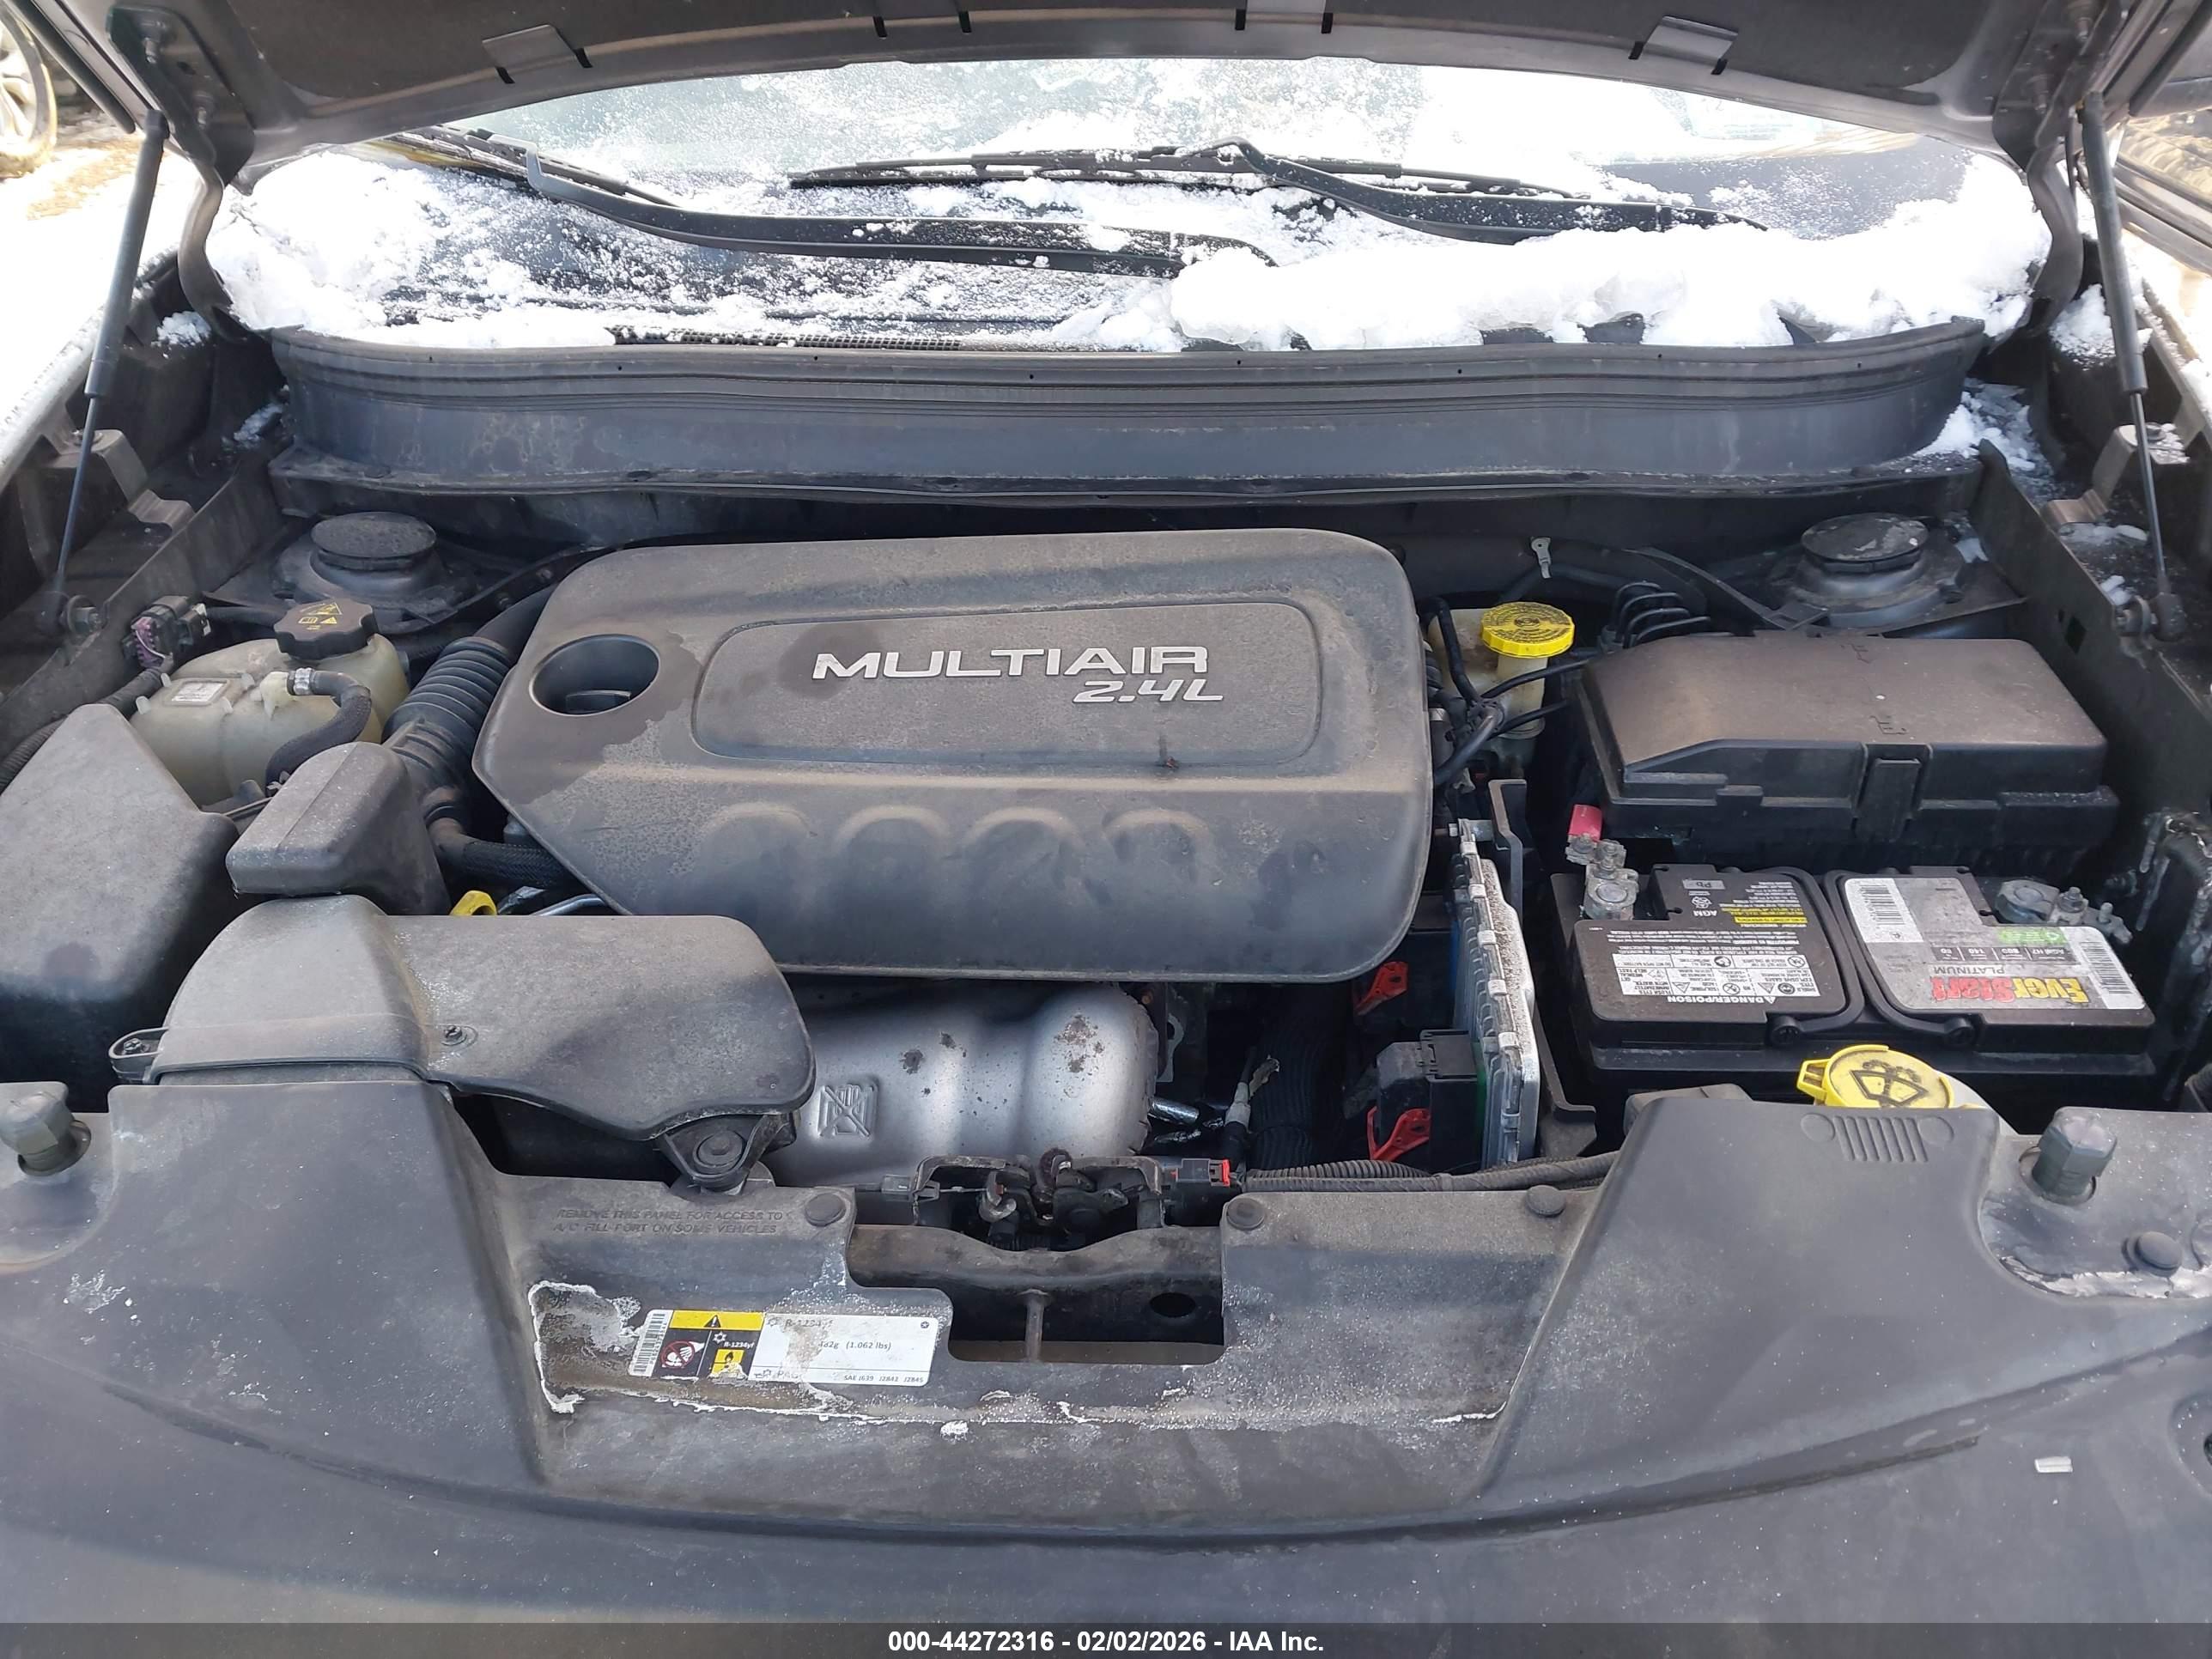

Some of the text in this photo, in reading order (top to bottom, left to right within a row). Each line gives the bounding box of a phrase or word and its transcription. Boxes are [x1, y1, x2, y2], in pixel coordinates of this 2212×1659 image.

[811, 645, 1210, 680] MULTIAIR
[1073, 678, 1224, 703] 2.4L
[1934, 965, 2006, 975] PLATINUM
[1930, 977, 2090, 1004] EverStart
[1667, 995, 1765, 1004] DANGER/POISON
[714, 1210, 764, 1220] ACCESS
[769, 1211, 783, 1220] TO
[717, 1224, 777, 1234] VEHICLES
[846, 1340, 873, 1350] (1.062
[875, 1341, 892, 1351] lbs)
